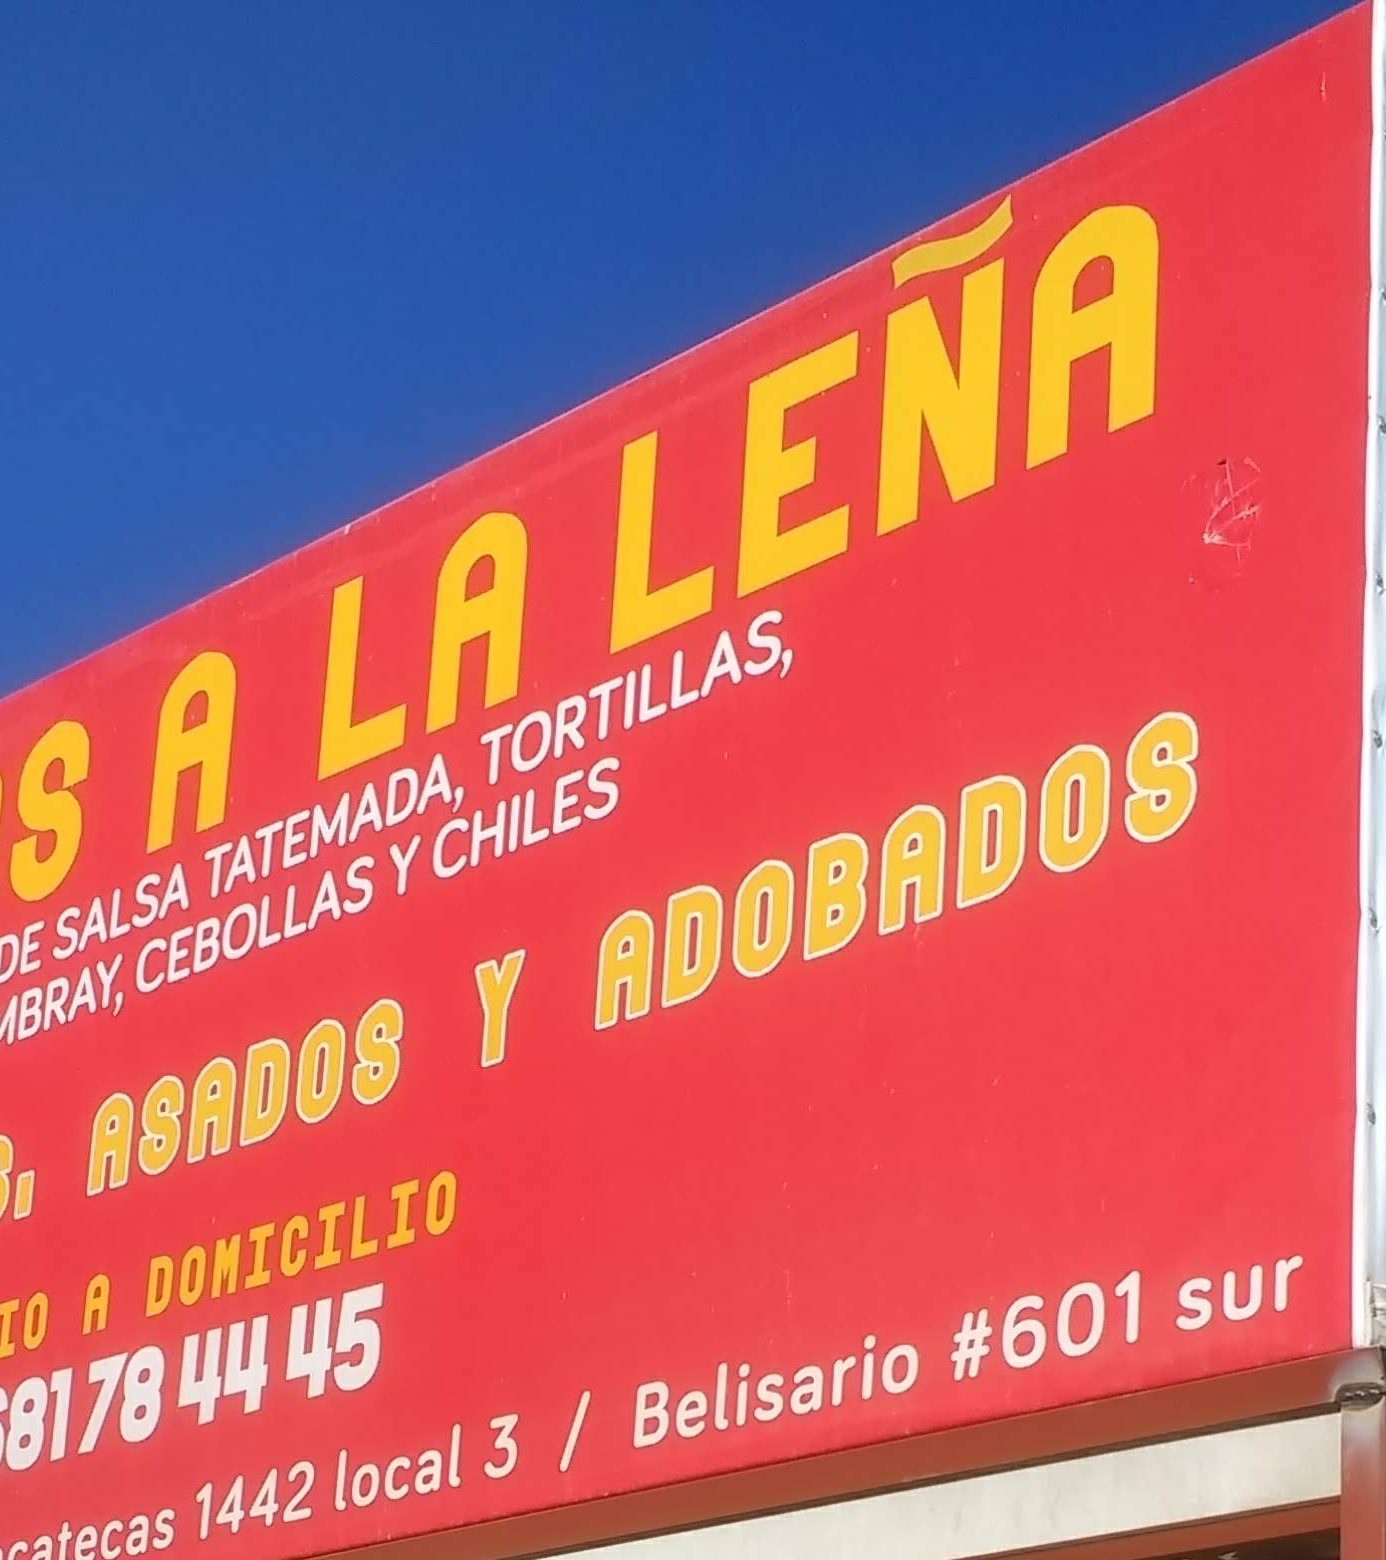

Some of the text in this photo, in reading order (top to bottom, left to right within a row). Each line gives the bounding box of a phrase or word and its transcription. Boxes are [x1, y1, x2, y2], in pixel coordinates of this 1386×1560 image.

[146, 651, 237, 854] A
[317, 511, 528, 781] LA
[609, 198, 1159, 654] LEÑA
[52, 863, 190, 960] SALSA
[204, 753, 465, 898] TATEMADA,
[480, 610, 793, 785] TORTILLAS,
[135, 855, 375, 993] CEBOLLAS
[389, 834, 422, 895] Y
[432, 756, 620, 878] CHILES
[86, 998, 404, 1197] ASADOS
[474, 948, 526, 1068] Y
[594, 711, 1199, 1031] ADOBADOS
[82, 1273, 110, 1335] A
[145, 1171, 458, 1318] DOMICILIO
[196, 1460, 315, 1540] 1442
[334, 1423, 461, 1511] local
[484, 1413, 519, 1479] 3
[559, 1390, 591, 1472] /
[633, 1334, 919, 1449] Belisario
[950, 1270, 1141, 1381] #601
[1175, 1255, 1304, 1331] sur
